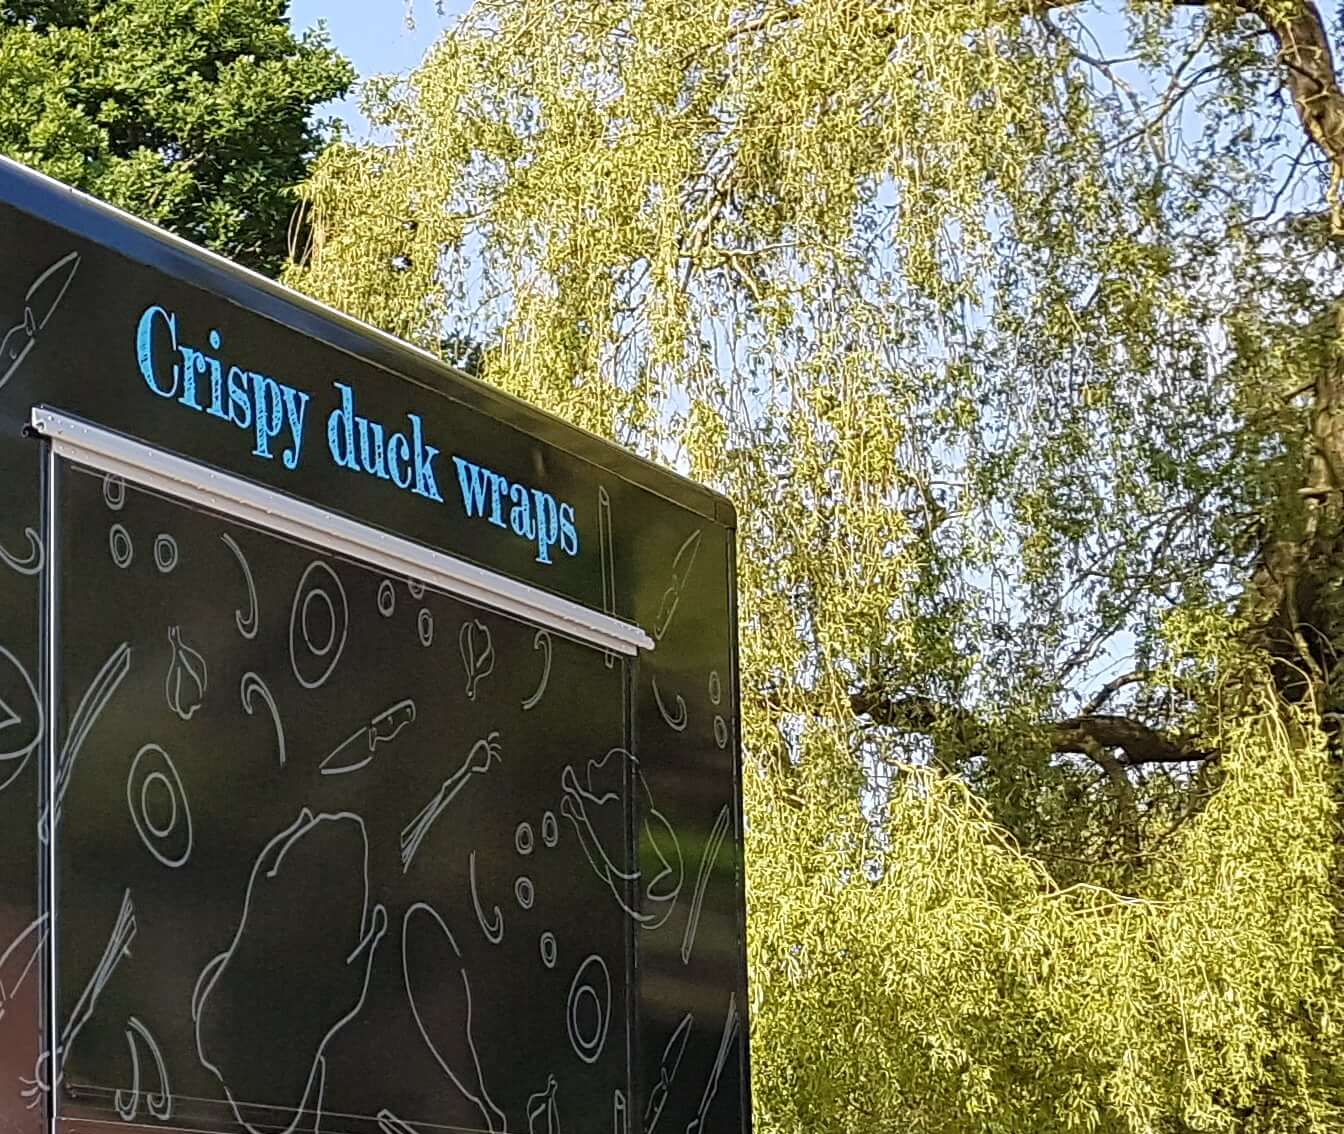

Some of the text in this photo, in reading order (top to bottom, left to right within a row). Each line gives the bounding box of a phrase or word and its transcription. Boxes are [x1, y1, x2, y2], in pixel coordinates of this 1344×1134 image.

[136, 305, 579, 565] Crispy duck wraps
